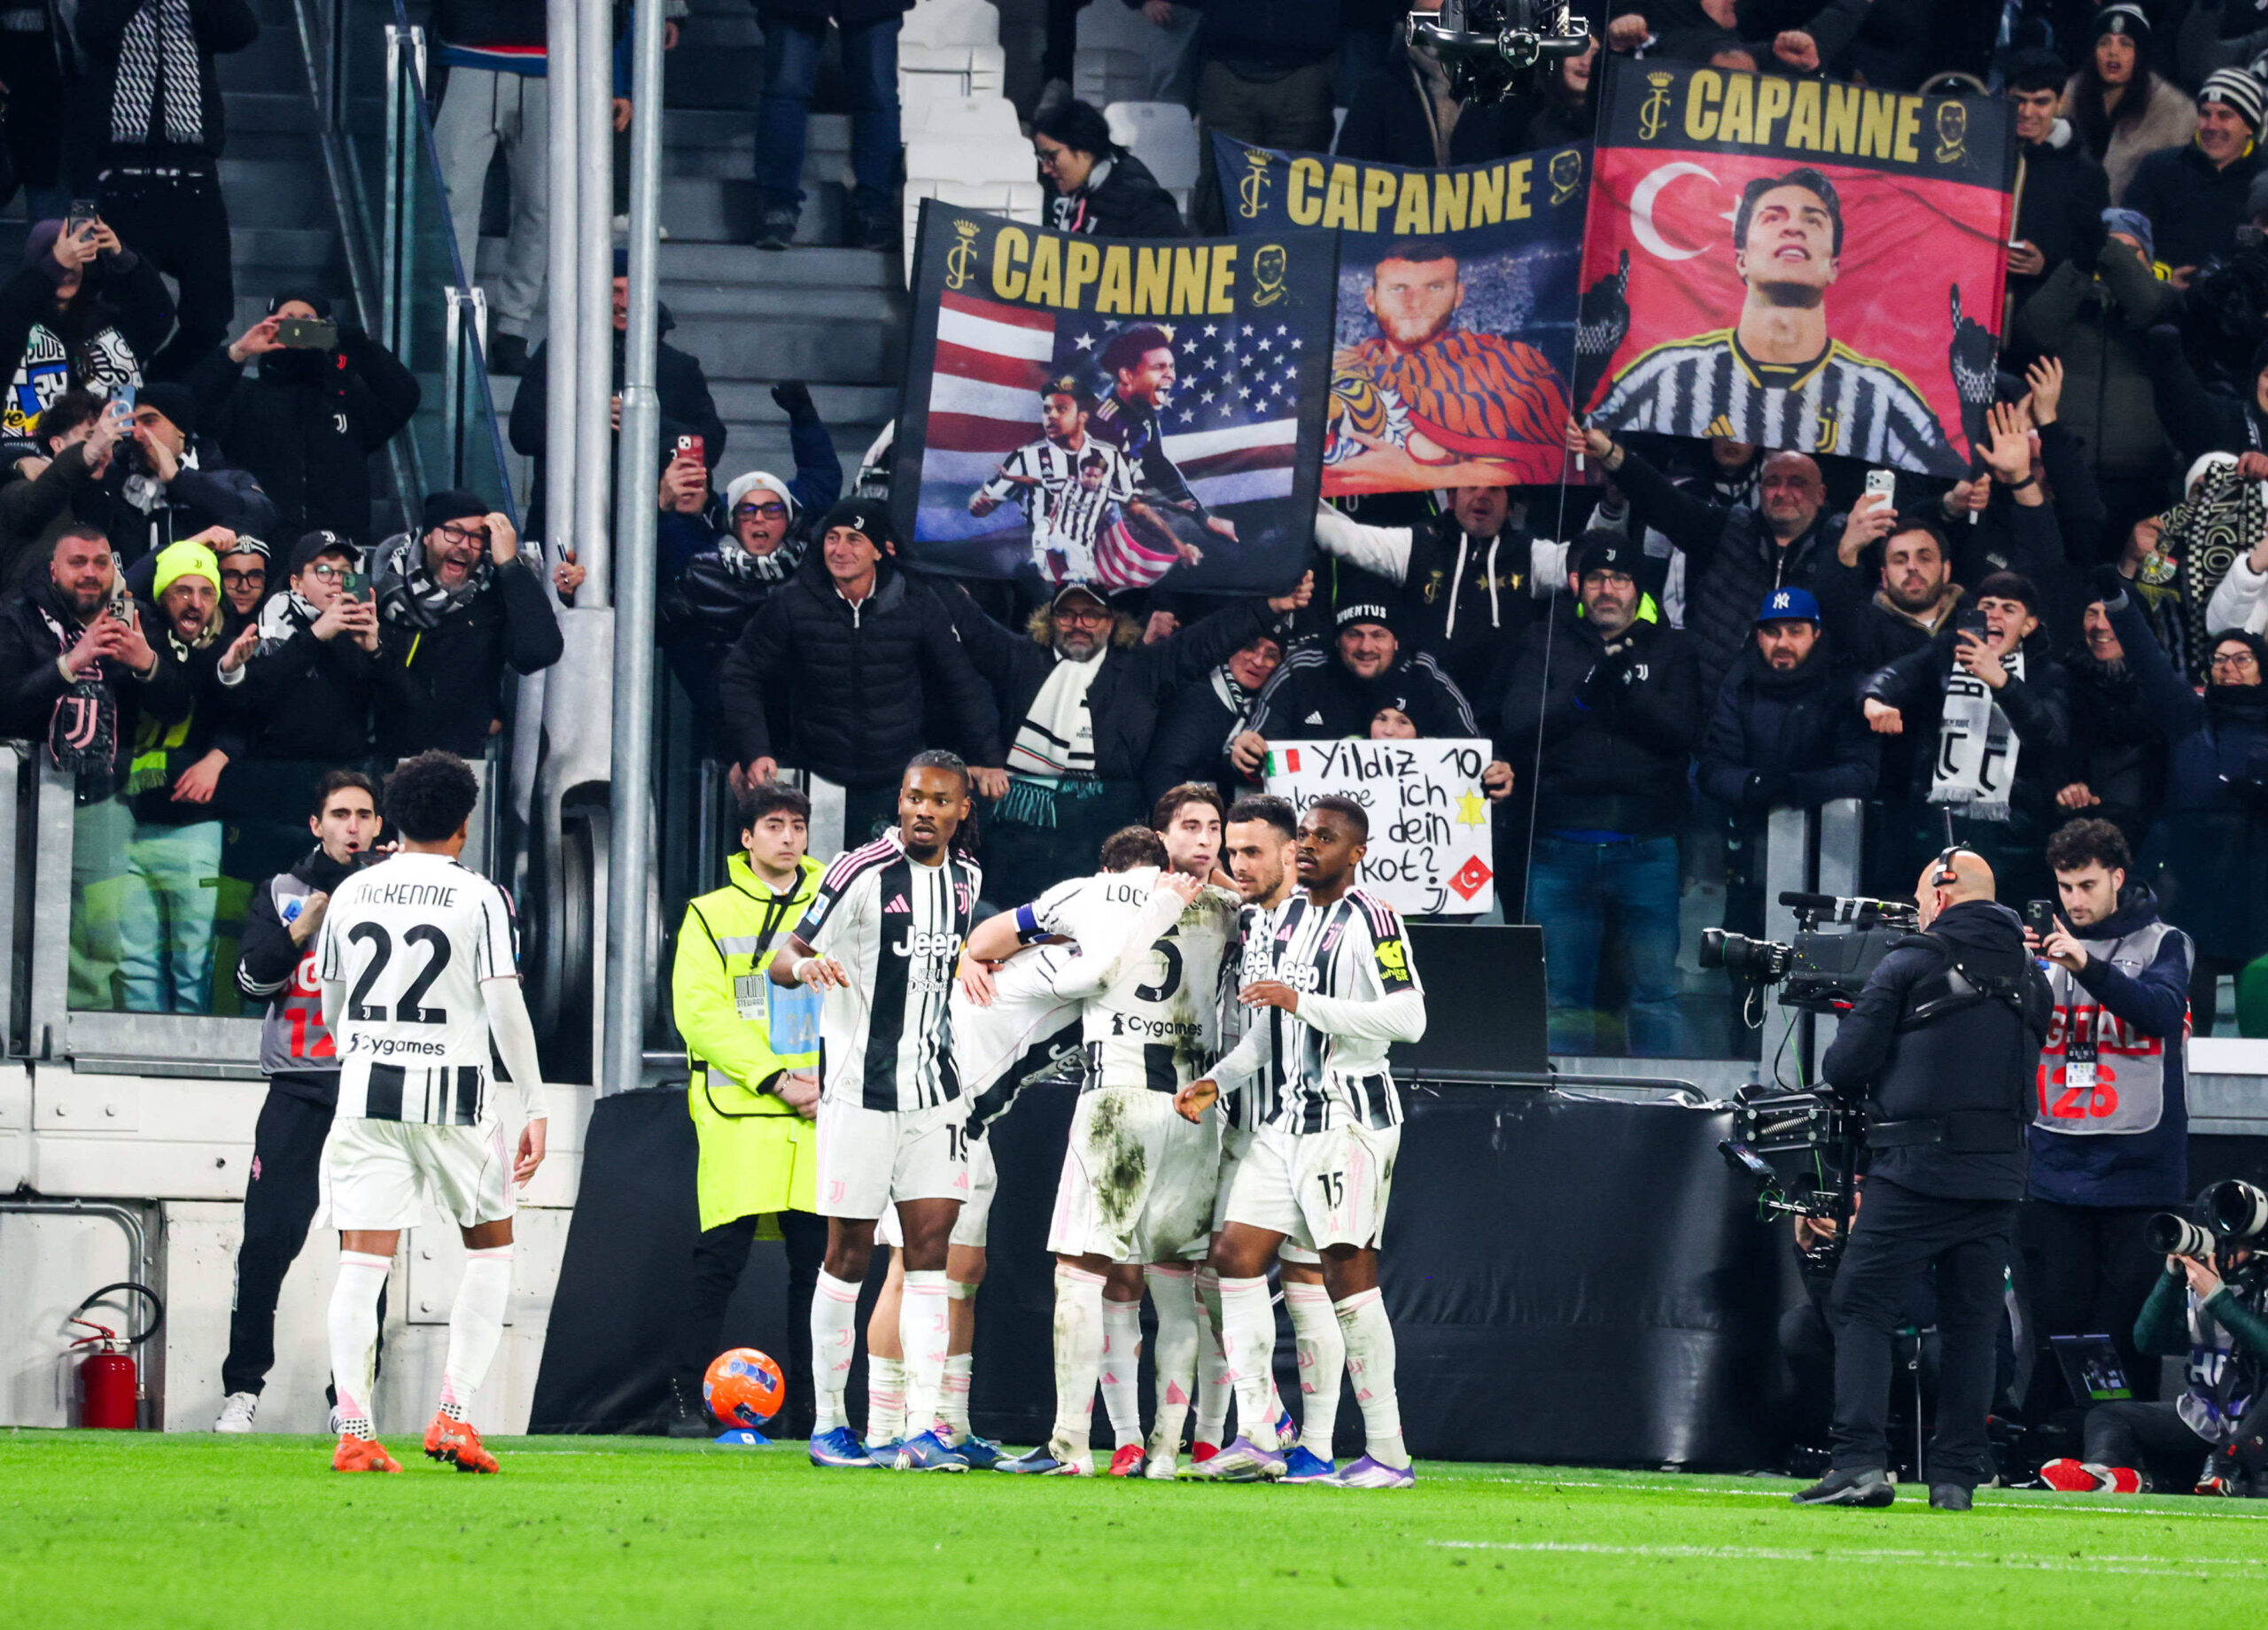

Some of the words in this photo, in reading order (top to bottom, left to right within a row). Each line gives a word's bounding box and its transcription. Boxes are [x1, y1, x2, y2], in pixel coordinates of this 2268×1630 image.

[1685, 69, 1923, 163] CAPANNE
[1286, 158, 1533, 234] CAPANNE
[992, 227, 1238, 314] CAPANNE
[1310, 741, 1419, 781] Yildiz
[1440, 748, 1482, 780] 10
[1398, 773, 1448, 808] ich
[1388, 807, 1451, 846] dein
[1106, 883, 1149, 908] LOC
[892, 924, 962, 964] Jeep
[347, 921, 452, 1025] 22
[1272, 951, 1320, 992] Jeep
[361, 1036, 446, 1056] Cygames
[1128, 1015, 1203, 1038] Cygames
[1317, 1170, 1343, 1211] 15
